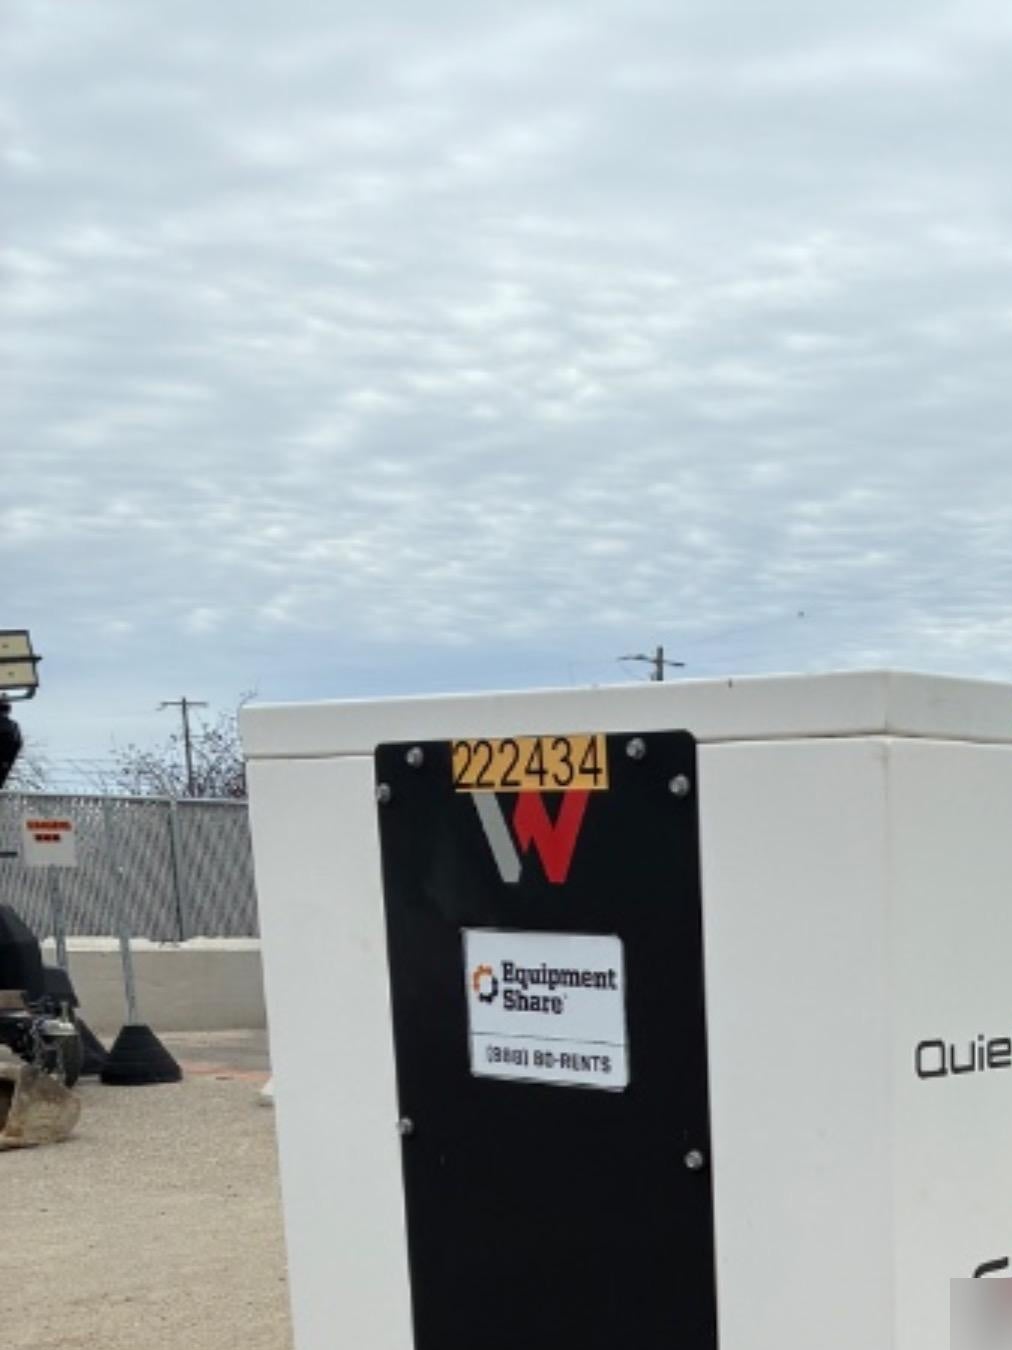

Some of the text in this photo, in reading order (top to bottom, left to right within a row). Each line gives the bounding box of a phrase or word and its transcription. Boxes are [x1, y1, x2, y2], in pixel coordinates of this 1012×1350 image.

[454, 735, 602, 788] 222434
[501, 960, 618, 991] Equipment
[503, 988, 564, 1015] Share
